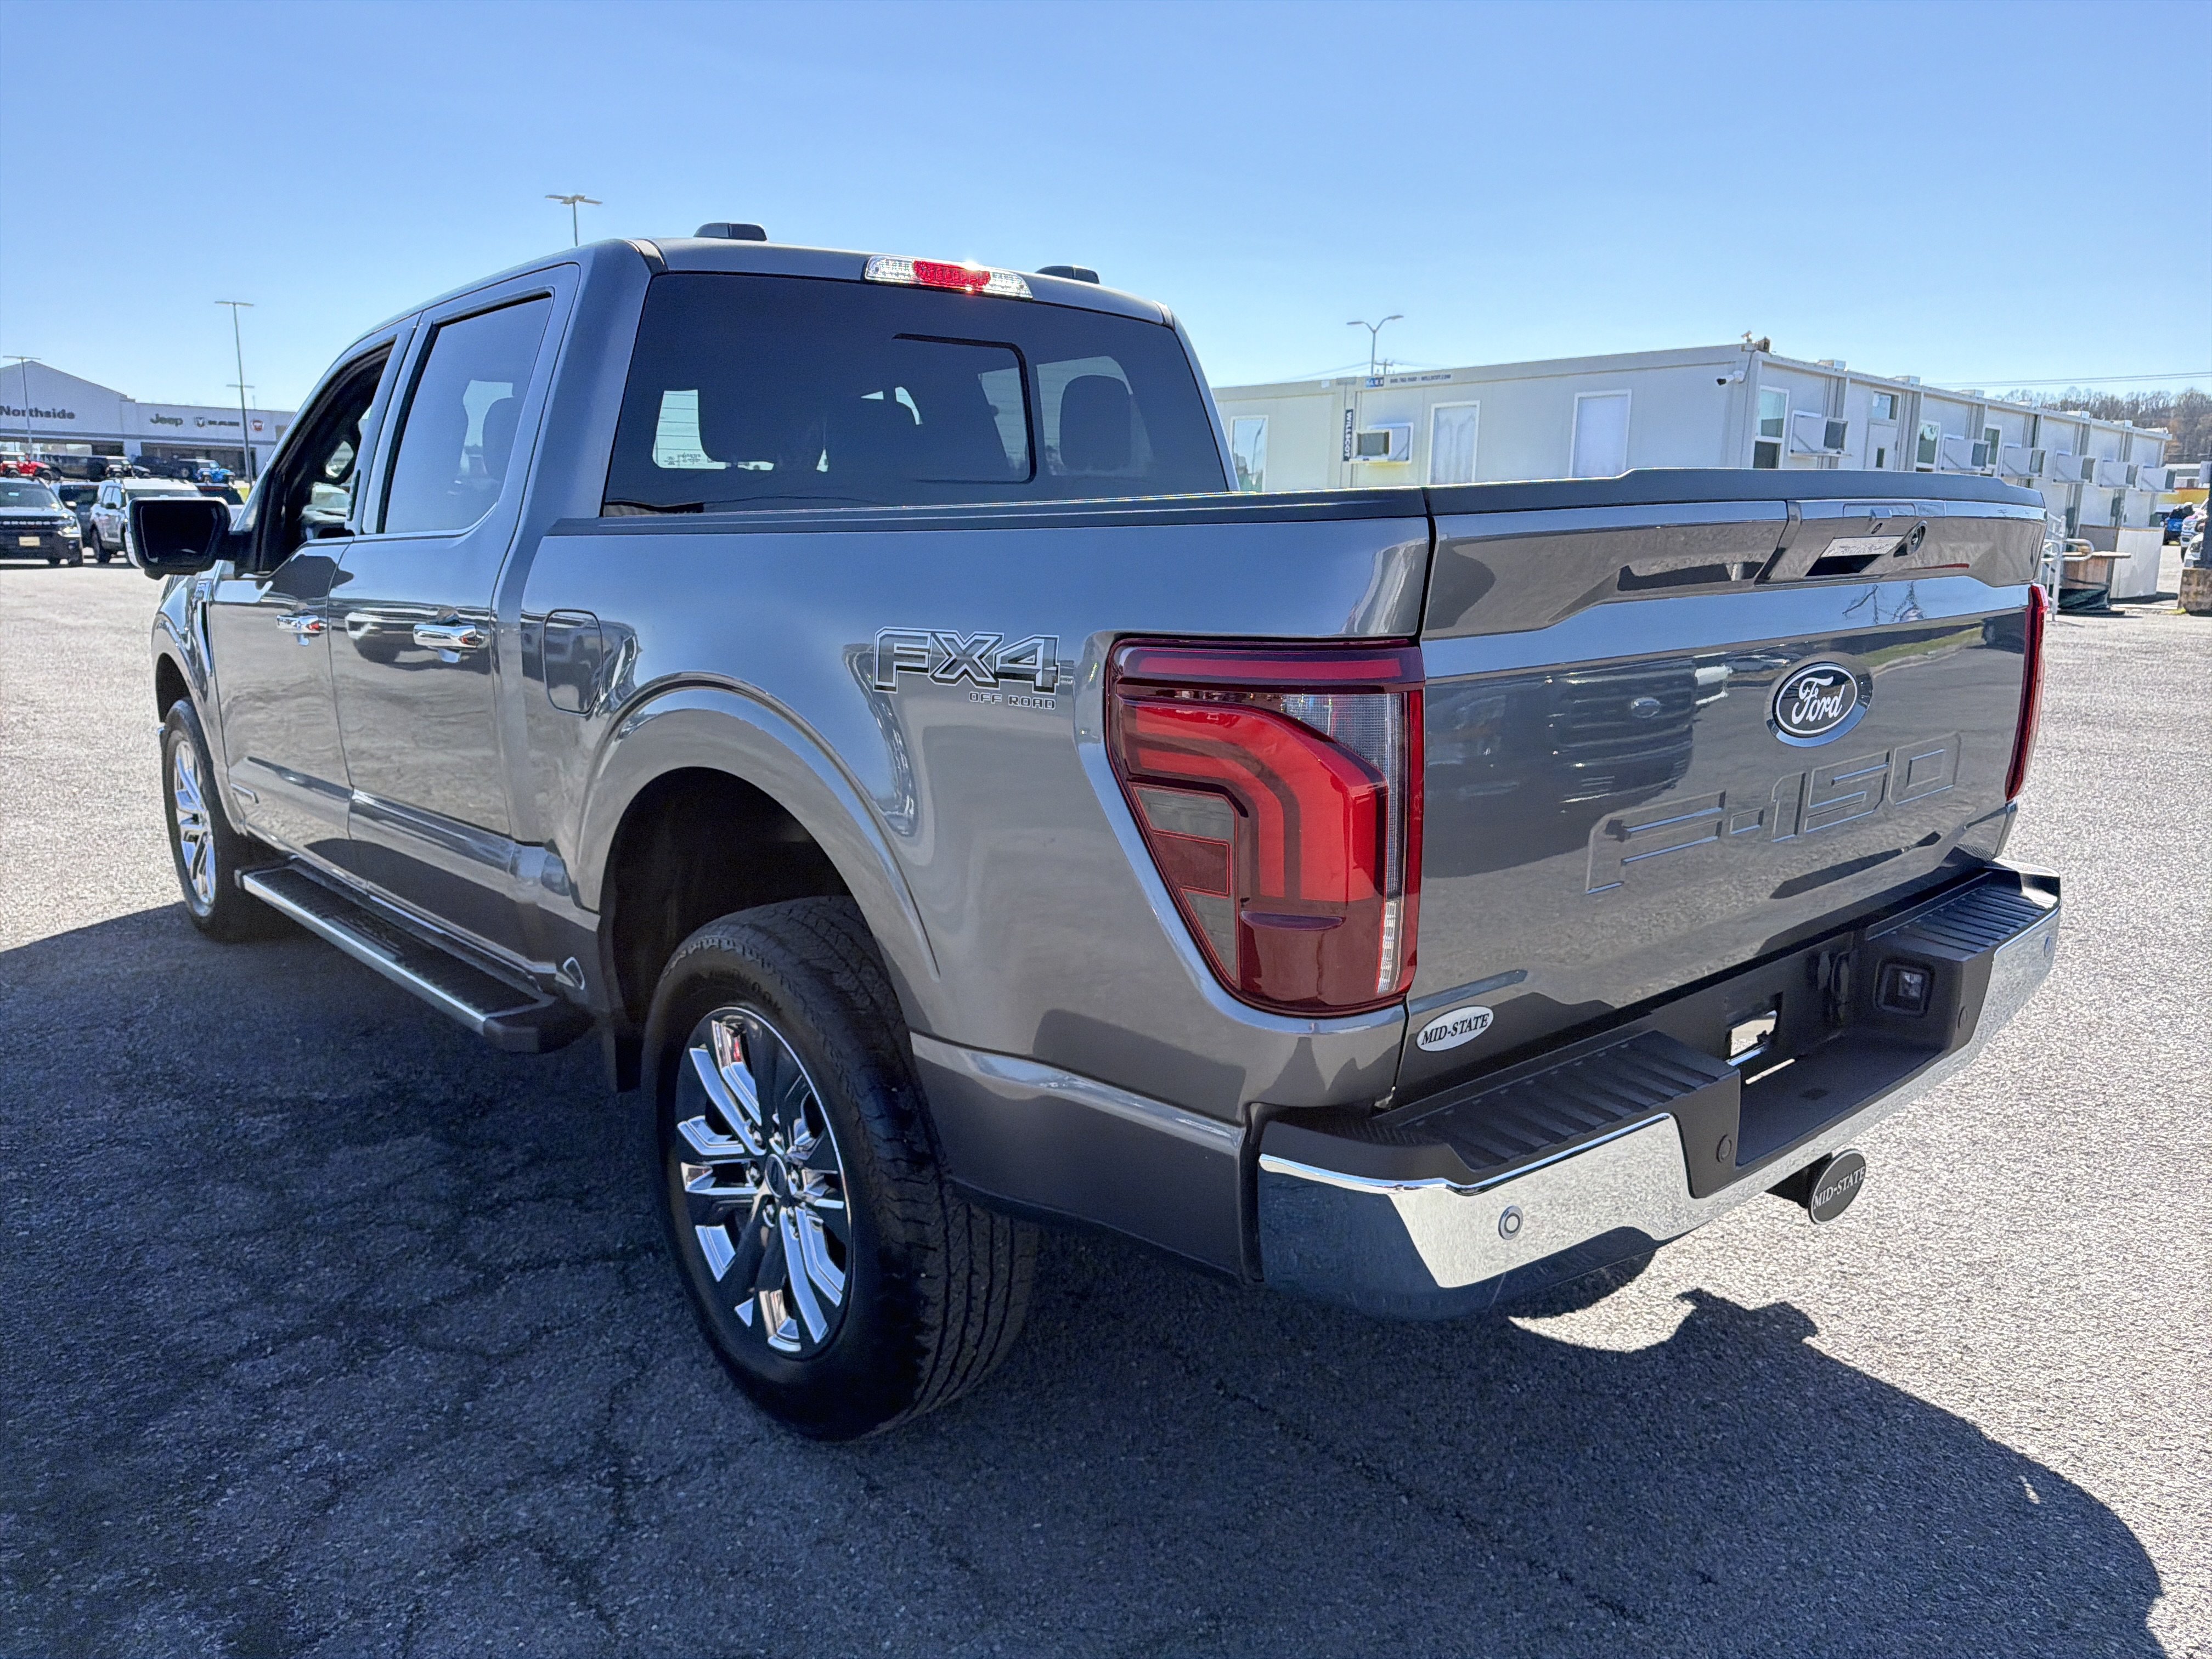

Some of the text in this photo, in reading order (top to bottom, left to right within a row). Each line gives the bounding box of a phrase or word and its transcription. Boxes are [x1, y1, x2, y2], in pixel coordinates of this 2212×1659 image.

[0, 405, 75, 419] Northside
[150, 413, 184, 427] Jeep
[1344, 411, 1352, 457] WILLSCOT
[873, 626, 1060, 694] FX4
[969, 691, 1056, 710] OFF ROAD
[1791, 676, 1845, 725] Ford
[1585, 732, 1962, 894] F-150
[1421, 1013, 1489, 1046] MID-STATE
[1813, 1166, 1865, 1210] MID-STATE
